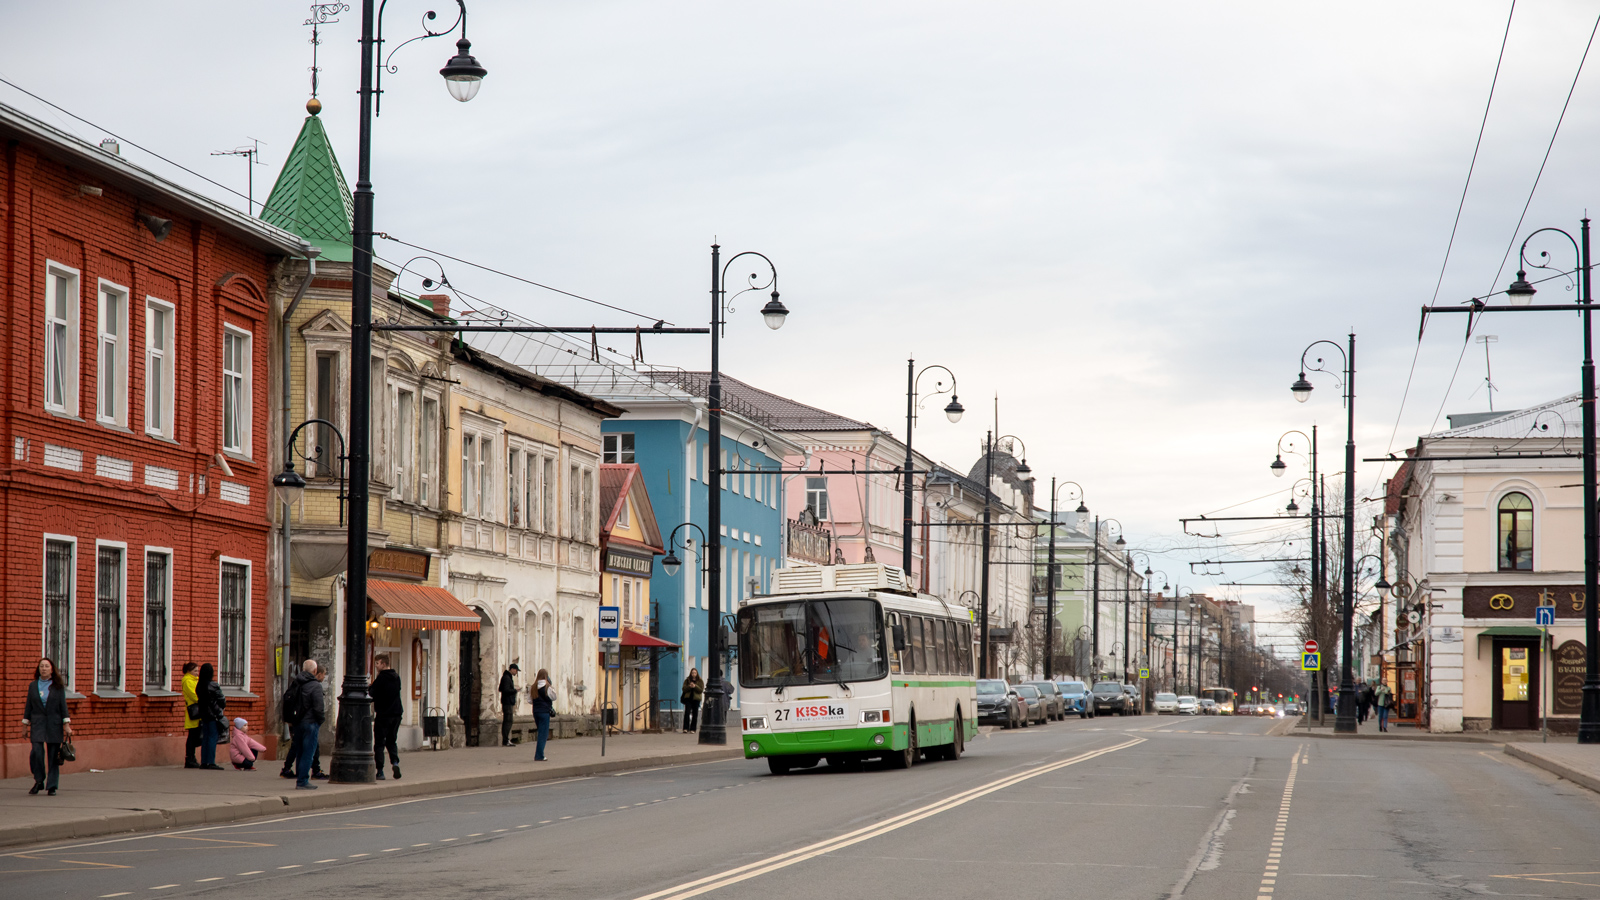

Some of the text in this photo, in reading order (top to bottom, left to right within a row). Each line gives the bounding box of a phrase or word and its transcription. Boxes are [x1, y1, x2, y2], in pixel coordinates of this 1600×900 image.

[609, 555, 650, 572] МУЖСКАЯ ОДЕЖДА
[774, 709, 790, 721] 27
